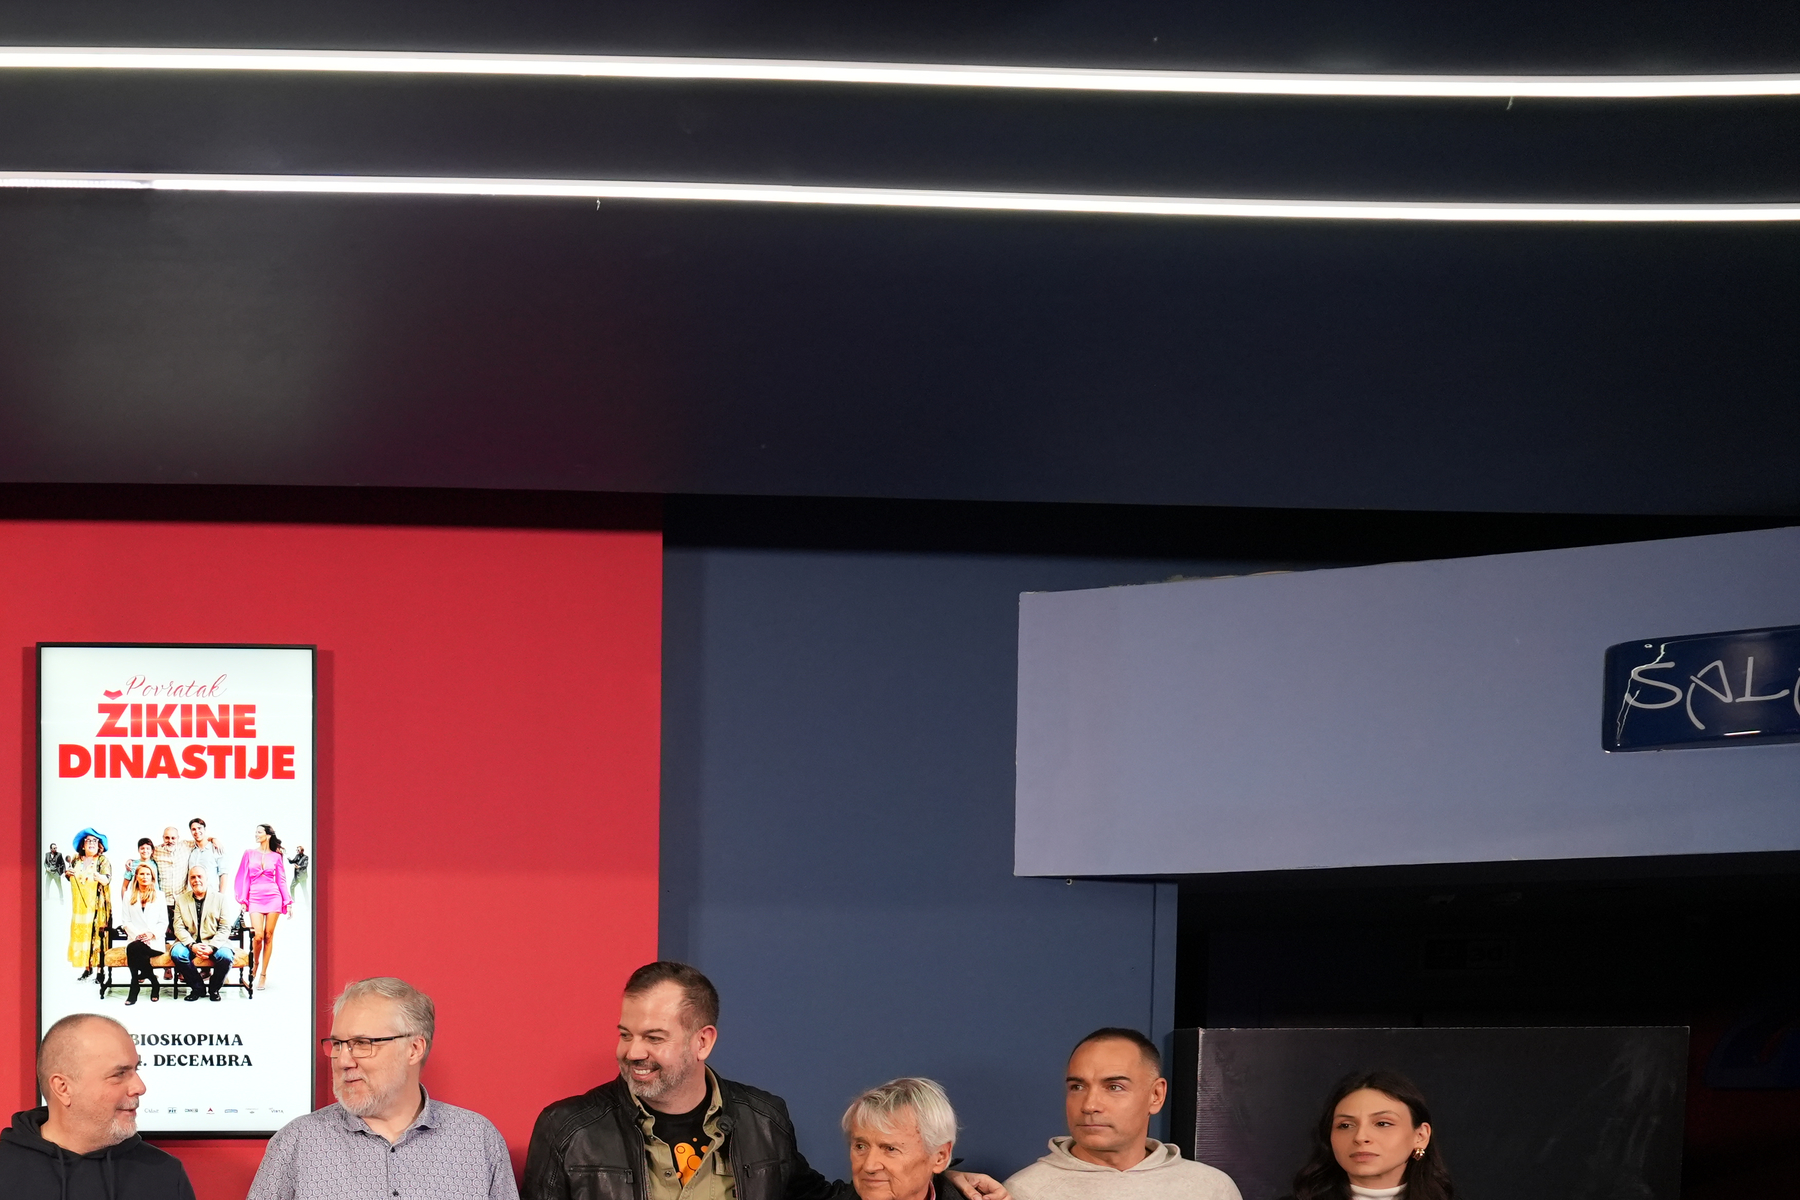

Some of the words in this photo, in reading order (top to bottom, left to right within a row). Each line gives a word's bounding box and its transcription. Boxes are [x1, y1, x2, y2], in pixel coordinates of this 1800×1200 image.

[126, 674, 227, 698] Povratak
[1625, 656, 1800, 730] SAL
[96, 690, 256, 738] ŽIKINE
[59, 744, 295, 780] DINASTIJE
[153, 1054, 253, 1067] DECEMBRA
